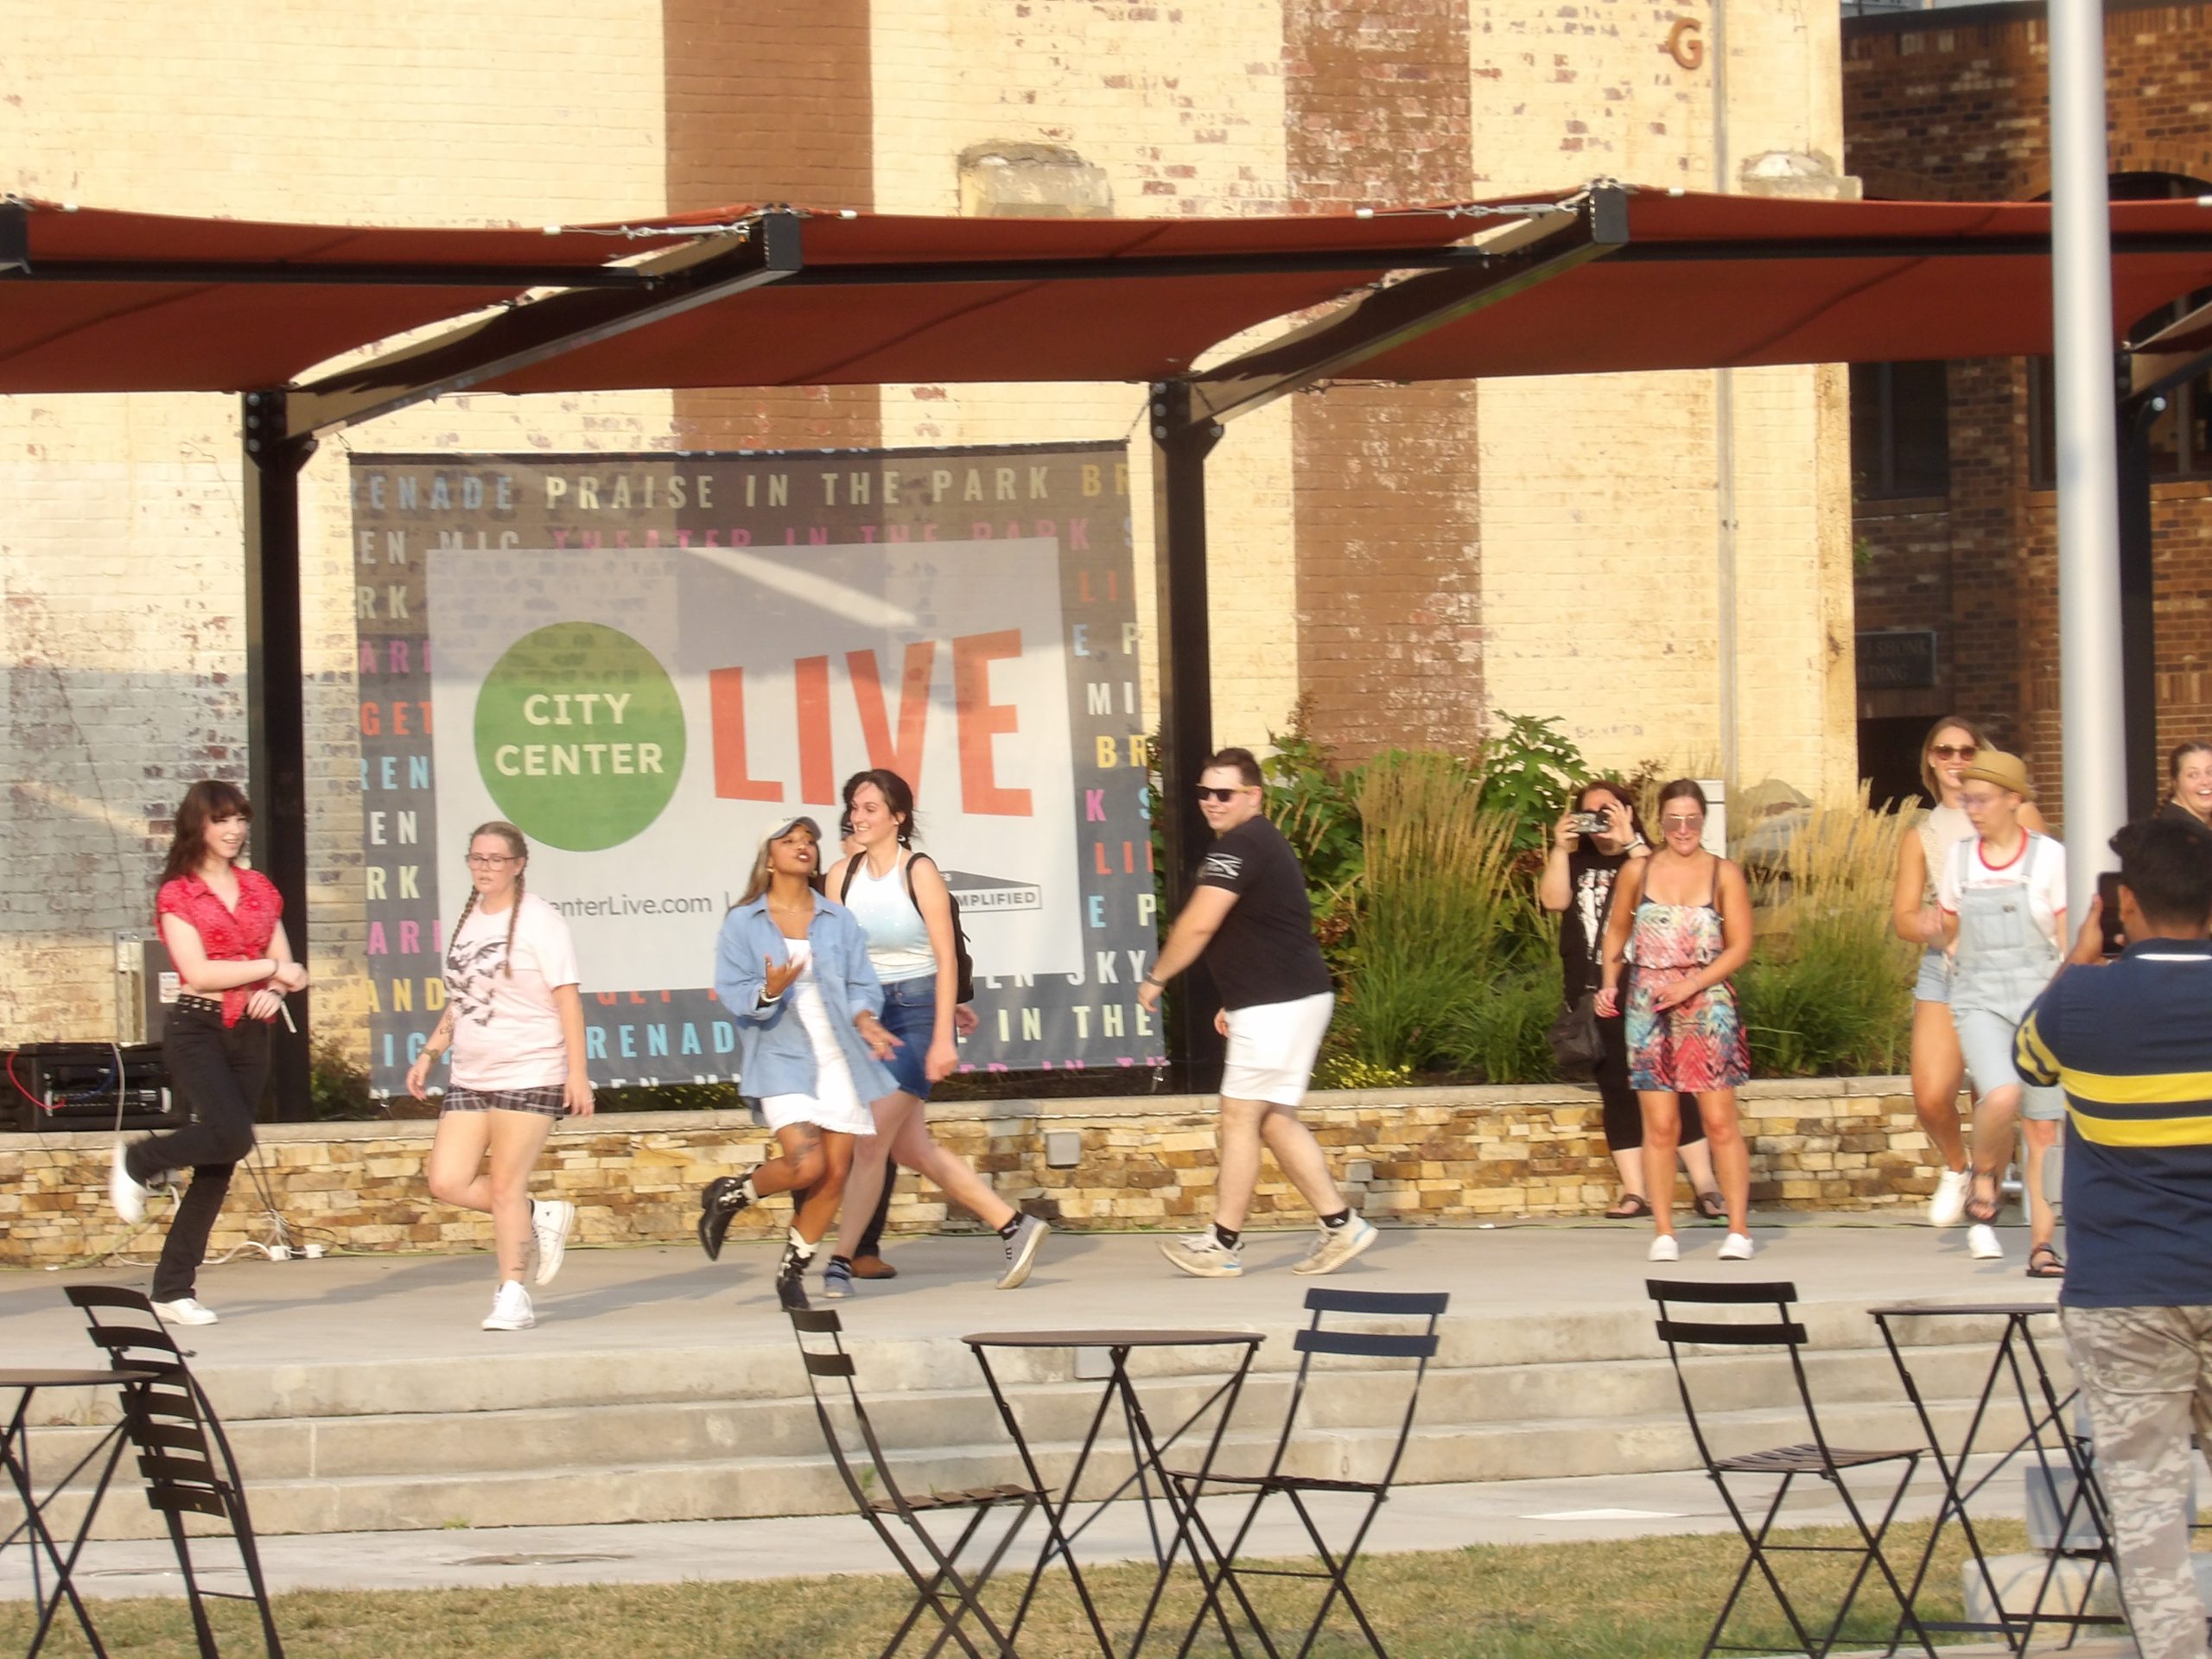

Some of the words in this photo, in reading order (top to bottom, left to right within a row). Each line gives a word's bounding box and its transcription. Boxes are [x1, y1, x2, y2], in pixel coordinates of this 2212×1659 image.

[1669, 17, 1703, 69] G
[546, 474, 714, 511] PRAISE
[746, 474, 789, 507] IN
[822, 471, 900, 506] THE
[931, 467, 1050, 503] PARK
[359, 531, 407, 565] EN
[524, 692, 632, 727] CITY
[709, 628, 1033, 817] LIVE
[495, 741, 664, 777] CENTER
[371, 810, 416, 845] EN
[998, 1007, 1042, 1042] IN
[1072, 1004, 1154, 1039] THE
